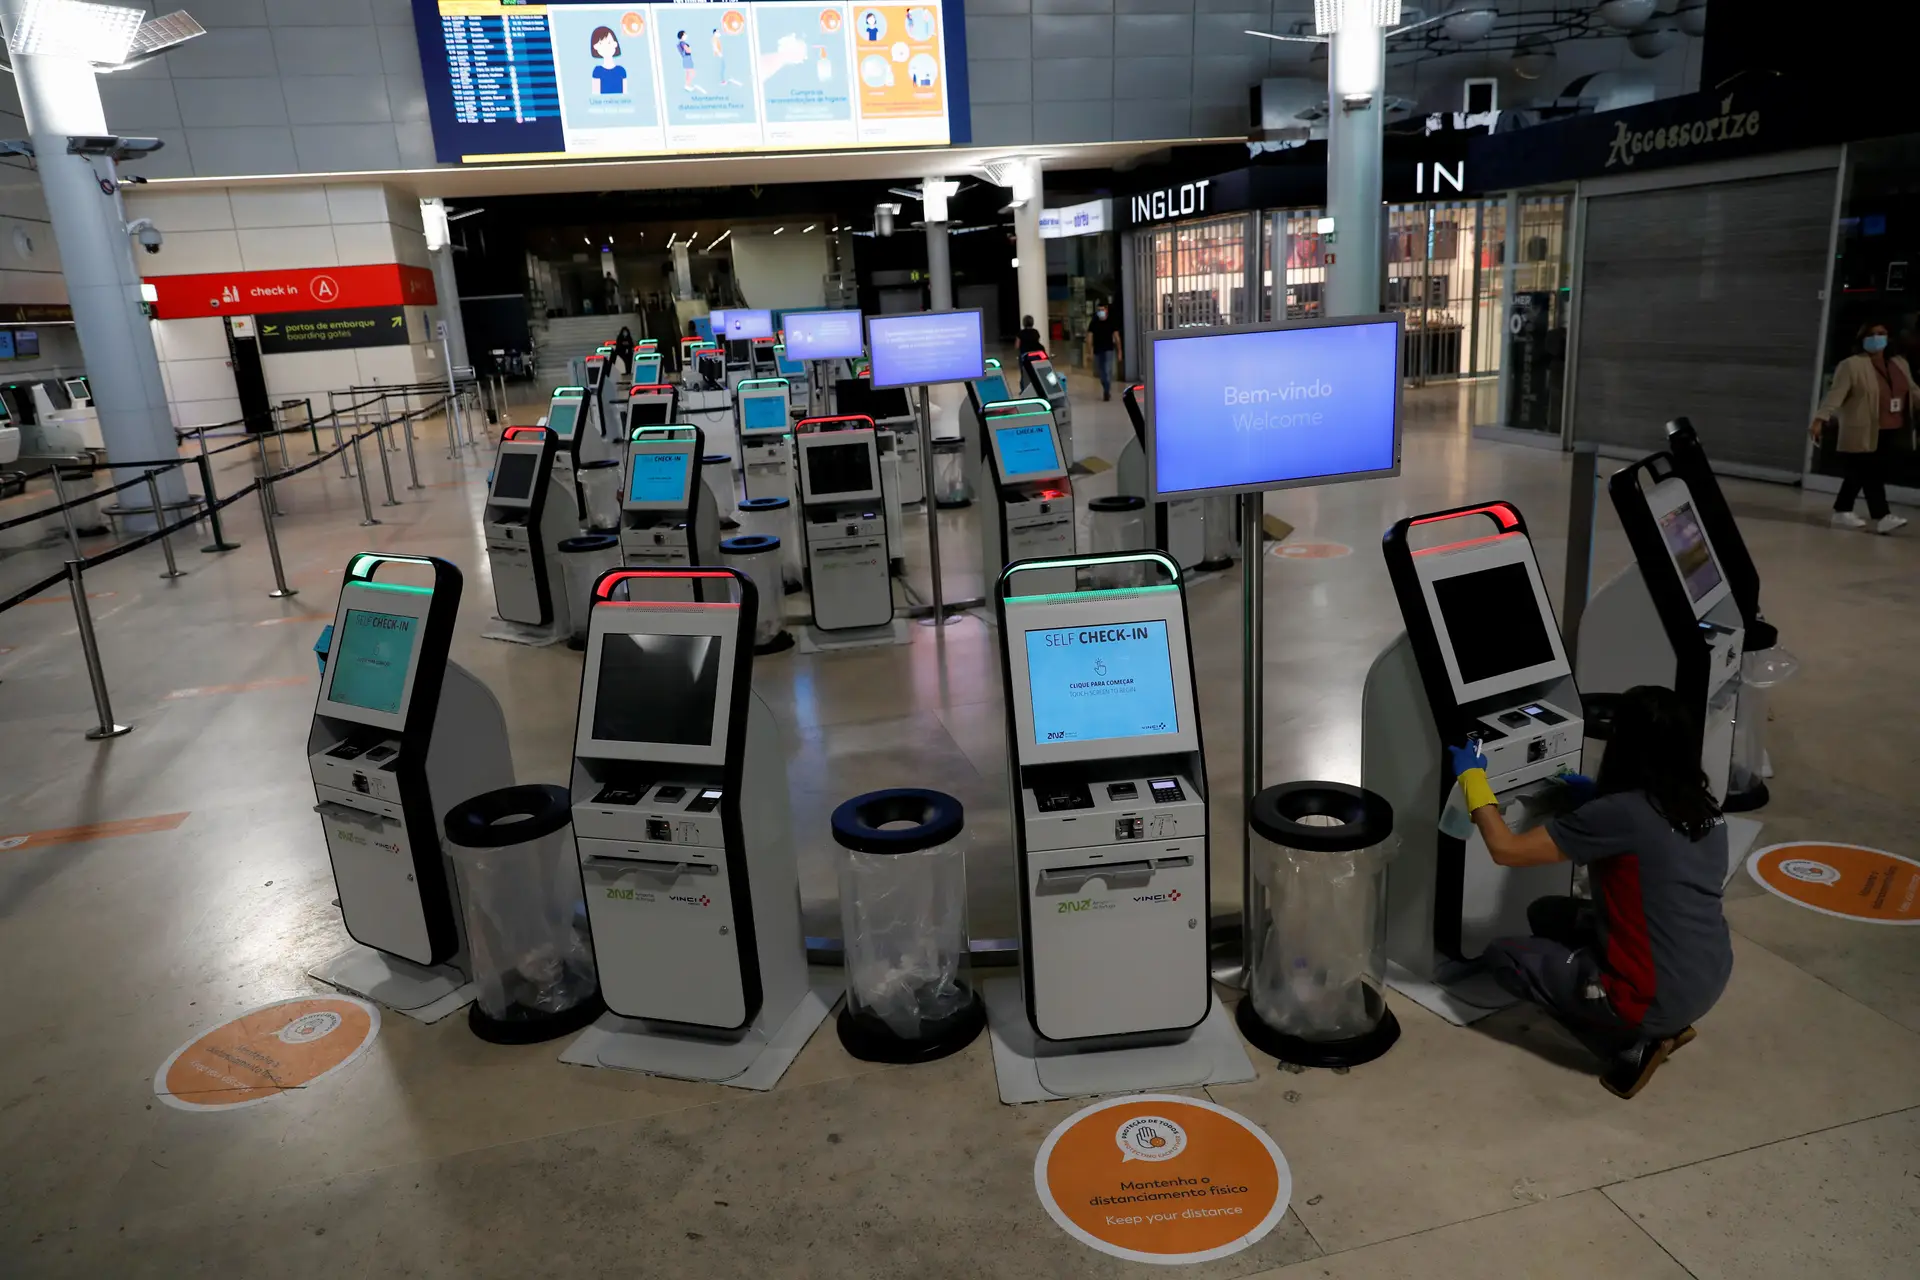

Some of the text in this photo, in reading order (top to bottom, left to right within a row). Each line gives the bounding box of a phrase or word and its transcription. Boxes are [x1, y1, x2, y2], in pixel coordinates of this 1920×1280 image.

[1604, 94, 1761, 168] Accessorize
[1416, 160, 1465, 194] IN
[1132, 180, 1210, 223] INGLOT
[250, 280, 332, 297] check in A
[285, 320, 375, 333] portas de embarque
[286, 329, 352, 341] boarding gates
[1224, 379, 1332, 406] Bem-vindo
[1233, 411, 1324, 432] Welcome
[372, 617, 410, 632] CHECK-IN
[1045, 627, 1148, 647] SELF CHECK-IN
[1069, 681, 1090, 690] CLIQUE
[1106, 678, 1134, 687] COMEÇAR
[1089, 688, 1110, 696] SCREEN
[669, 895, 697, 903] VINCI
[1133, 894, 1166, 902] VINCI
[1121, 1119, 1147, 1139] PROTEÇÃO
[1159, 1120, 1179, 1135] TODOS
[1120, 1177, 1210, 1191] Mantenha o
[1089, 1185, 1248, 1206] distanciamento físico
[1105, 1206, 1243, 1227] Keep your distance
